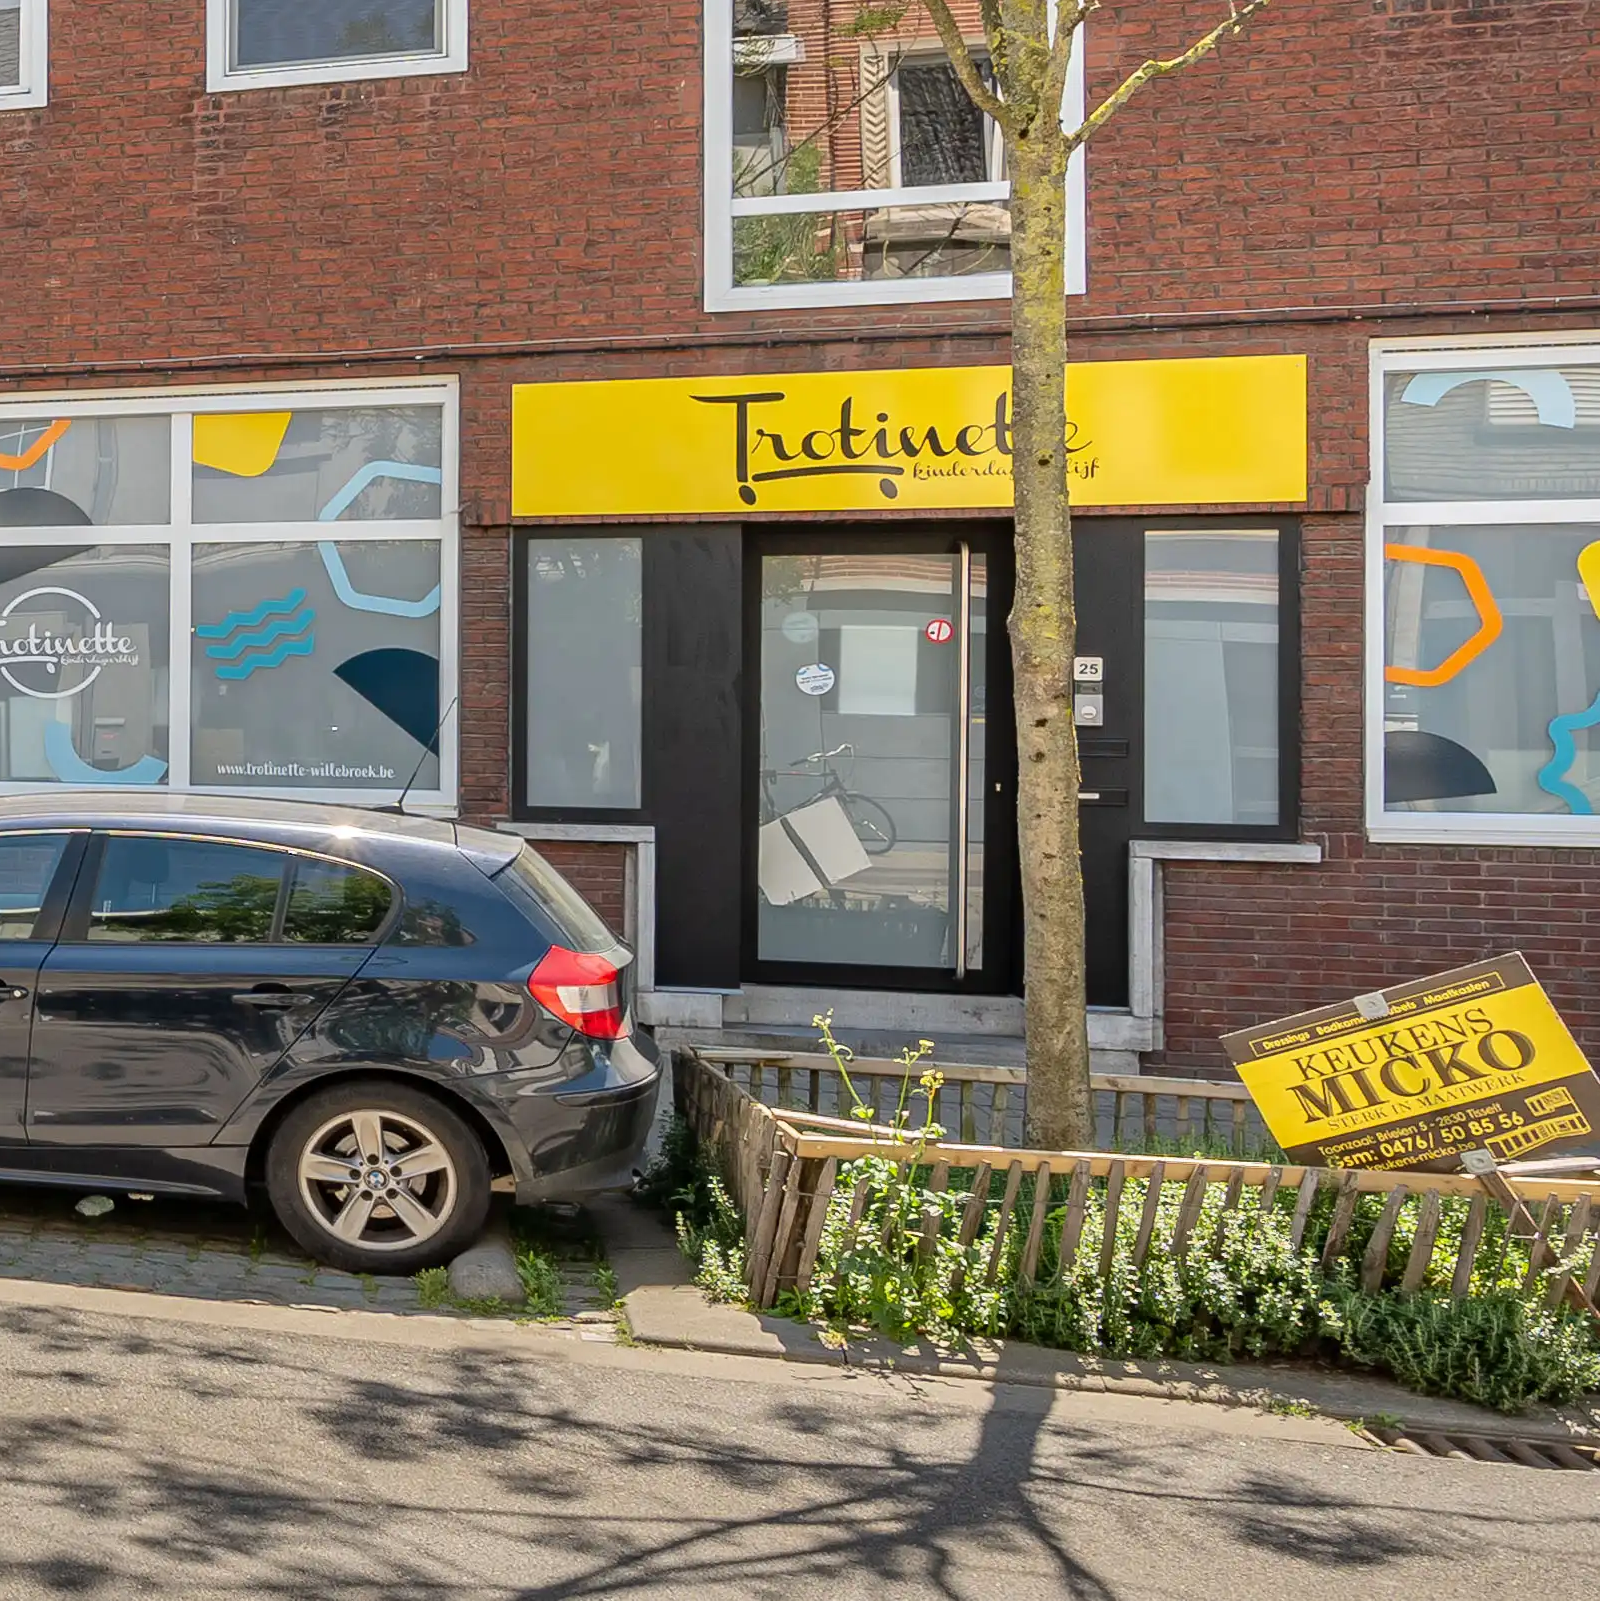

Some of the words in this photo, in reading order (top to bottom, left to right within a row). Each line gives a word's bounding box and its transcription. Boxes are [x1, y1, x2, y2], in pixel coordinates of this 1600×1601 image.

[688, 391, 1093, 490] Trotinete
[1079, 663, 1099, 675] 25
[217, 760, 396, 780] www.trotinette-willebroek.be
[1262, 1030, 1310, 1051] Dressings
[1422, 978, 1492, 1005] Maatkasten
[1291, 1007, 1495, 1082] KEUKENS
[1285, 1028, 1537, 1125] MICKO
[1327, 1106, 1388, 1132] STERK
[1391, 1099, 1413, 1115] IN
[1415, 1071, 1527, 1108] MAATWERK
[1380, 1131, 1435, 1159] 0476/
[1441, 1124, 1467, 1144] 50
[1471, 1117, 1496, 1137] 85
[1499, 1110, 1526, 1130] 56
[1418, 1119, 1429, 1133] 5
[1438, 1110, 1467, 1129] 2830
